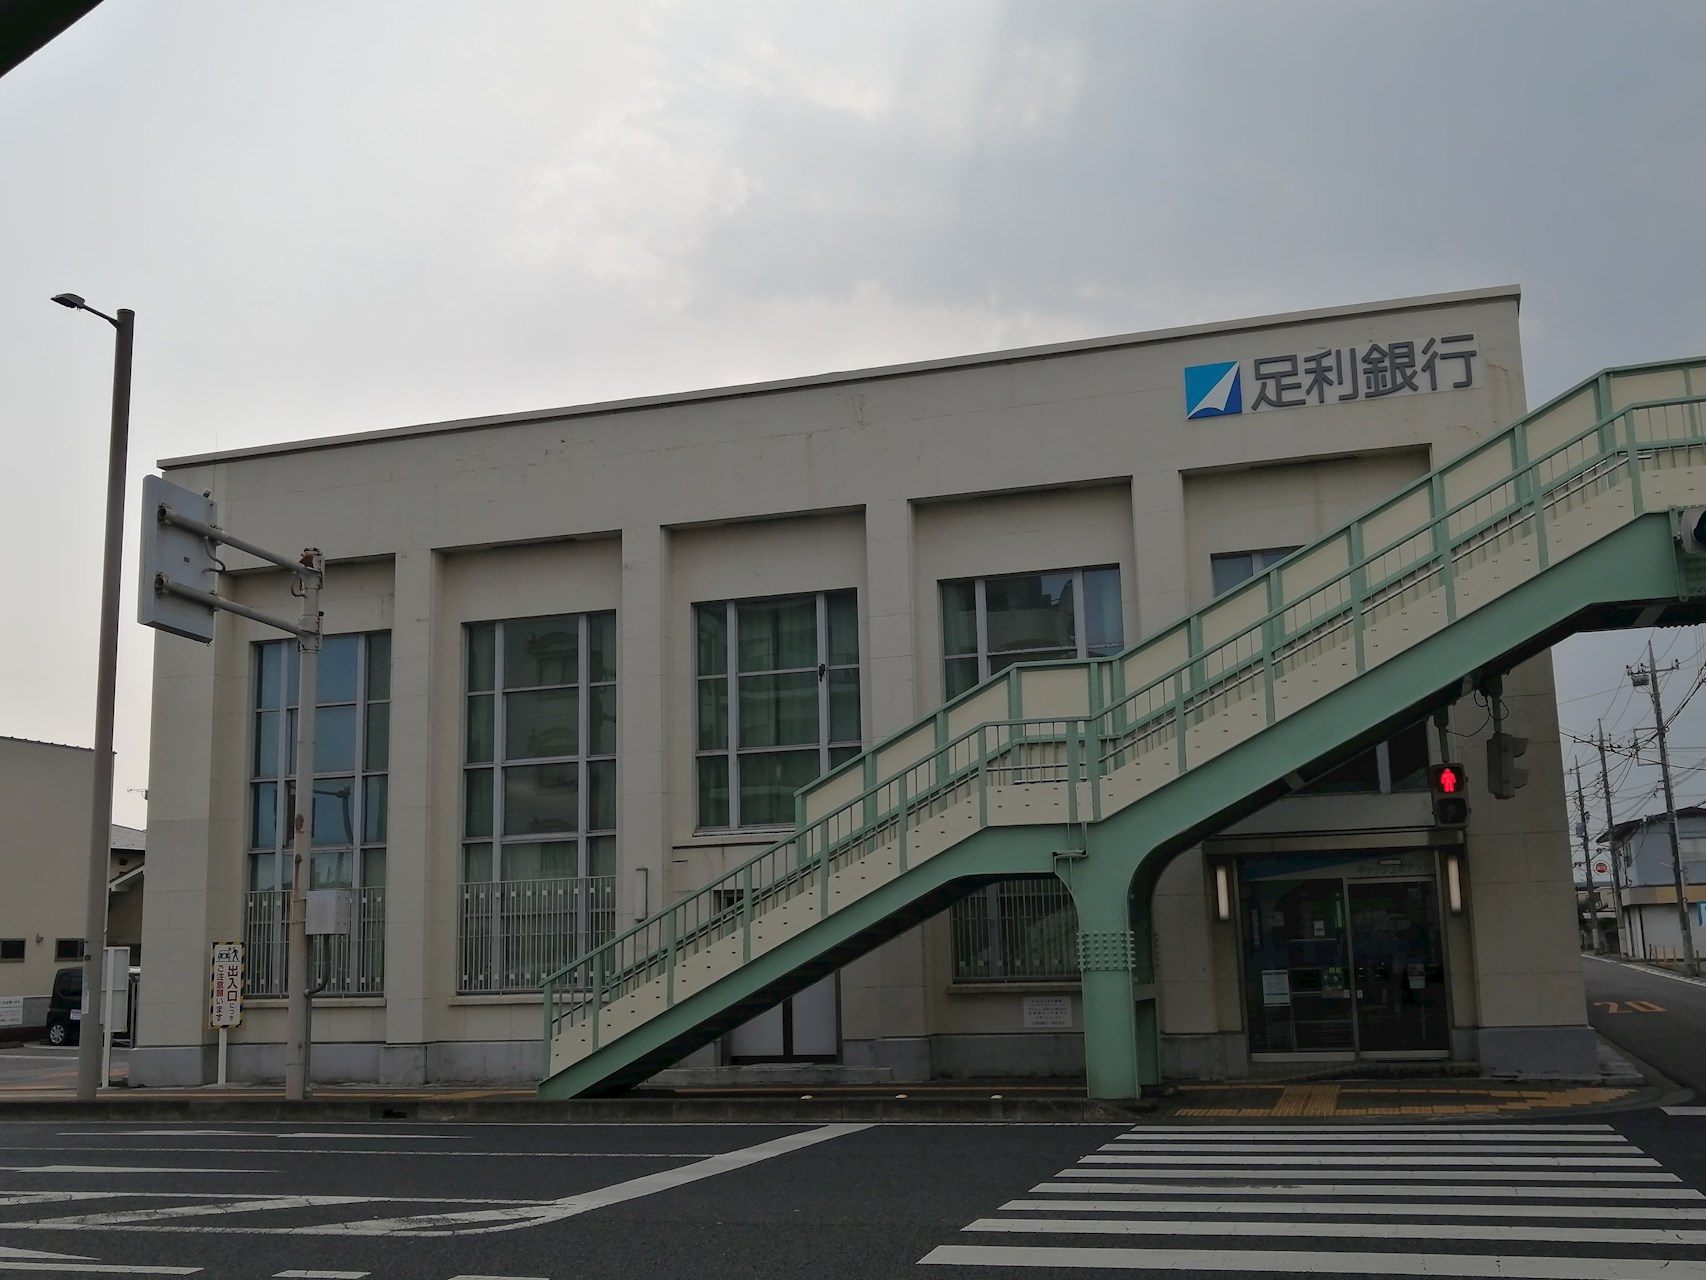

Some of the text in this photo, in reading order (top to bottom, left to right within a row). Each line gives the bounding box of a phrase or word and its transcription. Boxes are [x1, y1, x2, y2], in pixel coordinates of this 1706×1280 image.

[1251, 334, 1477, 411] 足利銀行
[215, 964, 225, 1022] ご注意願います
[227, 964, 238, 1021] 出入口につき
[1593, 1001, 1667, 1014] 20
